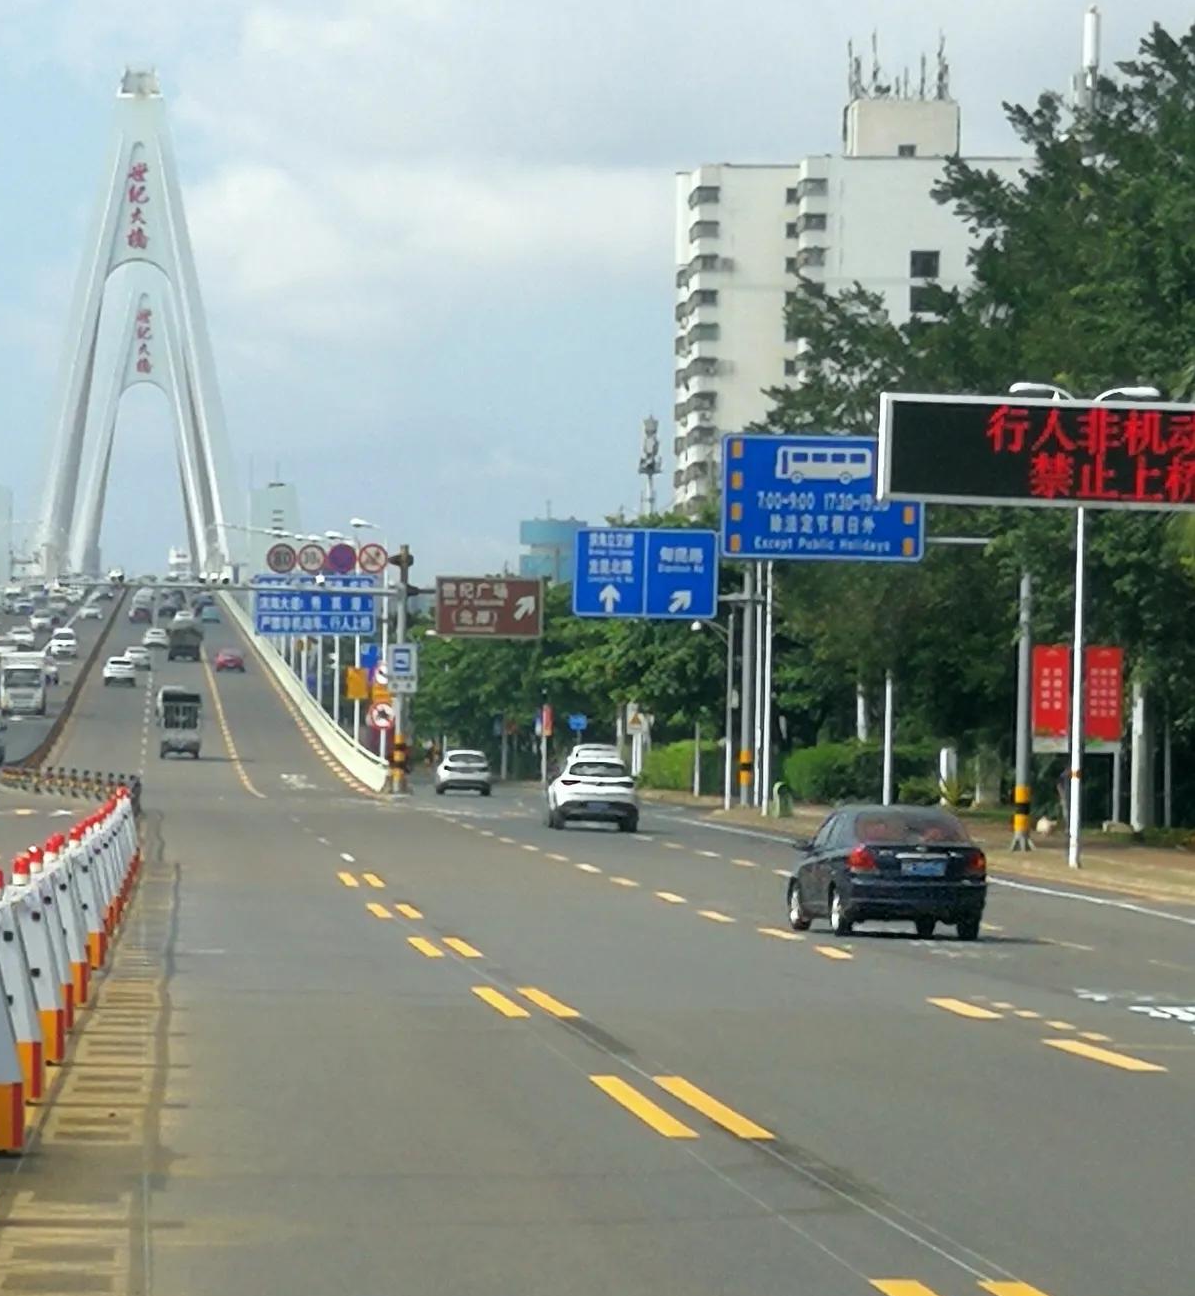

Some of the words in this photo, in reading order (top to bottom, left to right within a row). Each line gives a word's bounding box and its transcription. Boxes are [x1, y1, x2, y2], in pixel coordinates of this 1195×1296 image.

[987, 404, 1195, 455] 行人非机动
[1030, 452, 1195, 502] 禁止上桥
